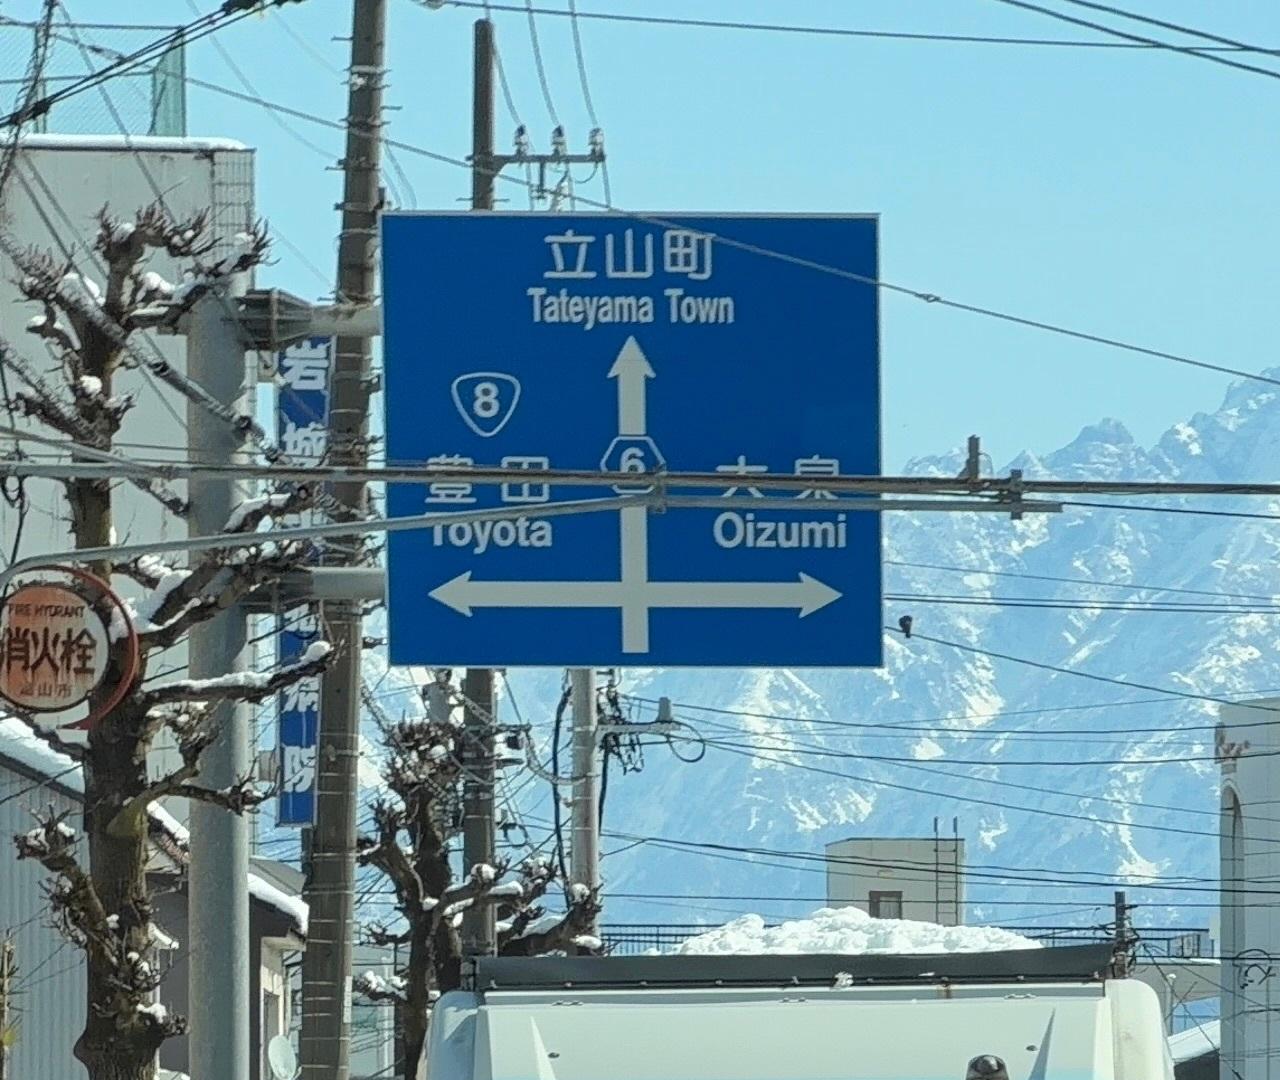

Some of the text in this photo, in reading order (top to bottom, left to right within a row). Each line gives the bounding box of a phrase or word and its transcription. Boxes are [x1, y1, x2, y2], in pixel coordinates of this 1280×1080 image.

[544, 228, 716, 281] 立山町
[527, 287, 735, 330] Tateyama Town
[473, 382, 500, 418] 8
[425, 455, 550, 503] 豊田
[427, 512, 553, 555] Toyota
[713, 511, 847, 549] Oizumi
[0, 626, 97, 676] 消火栓
